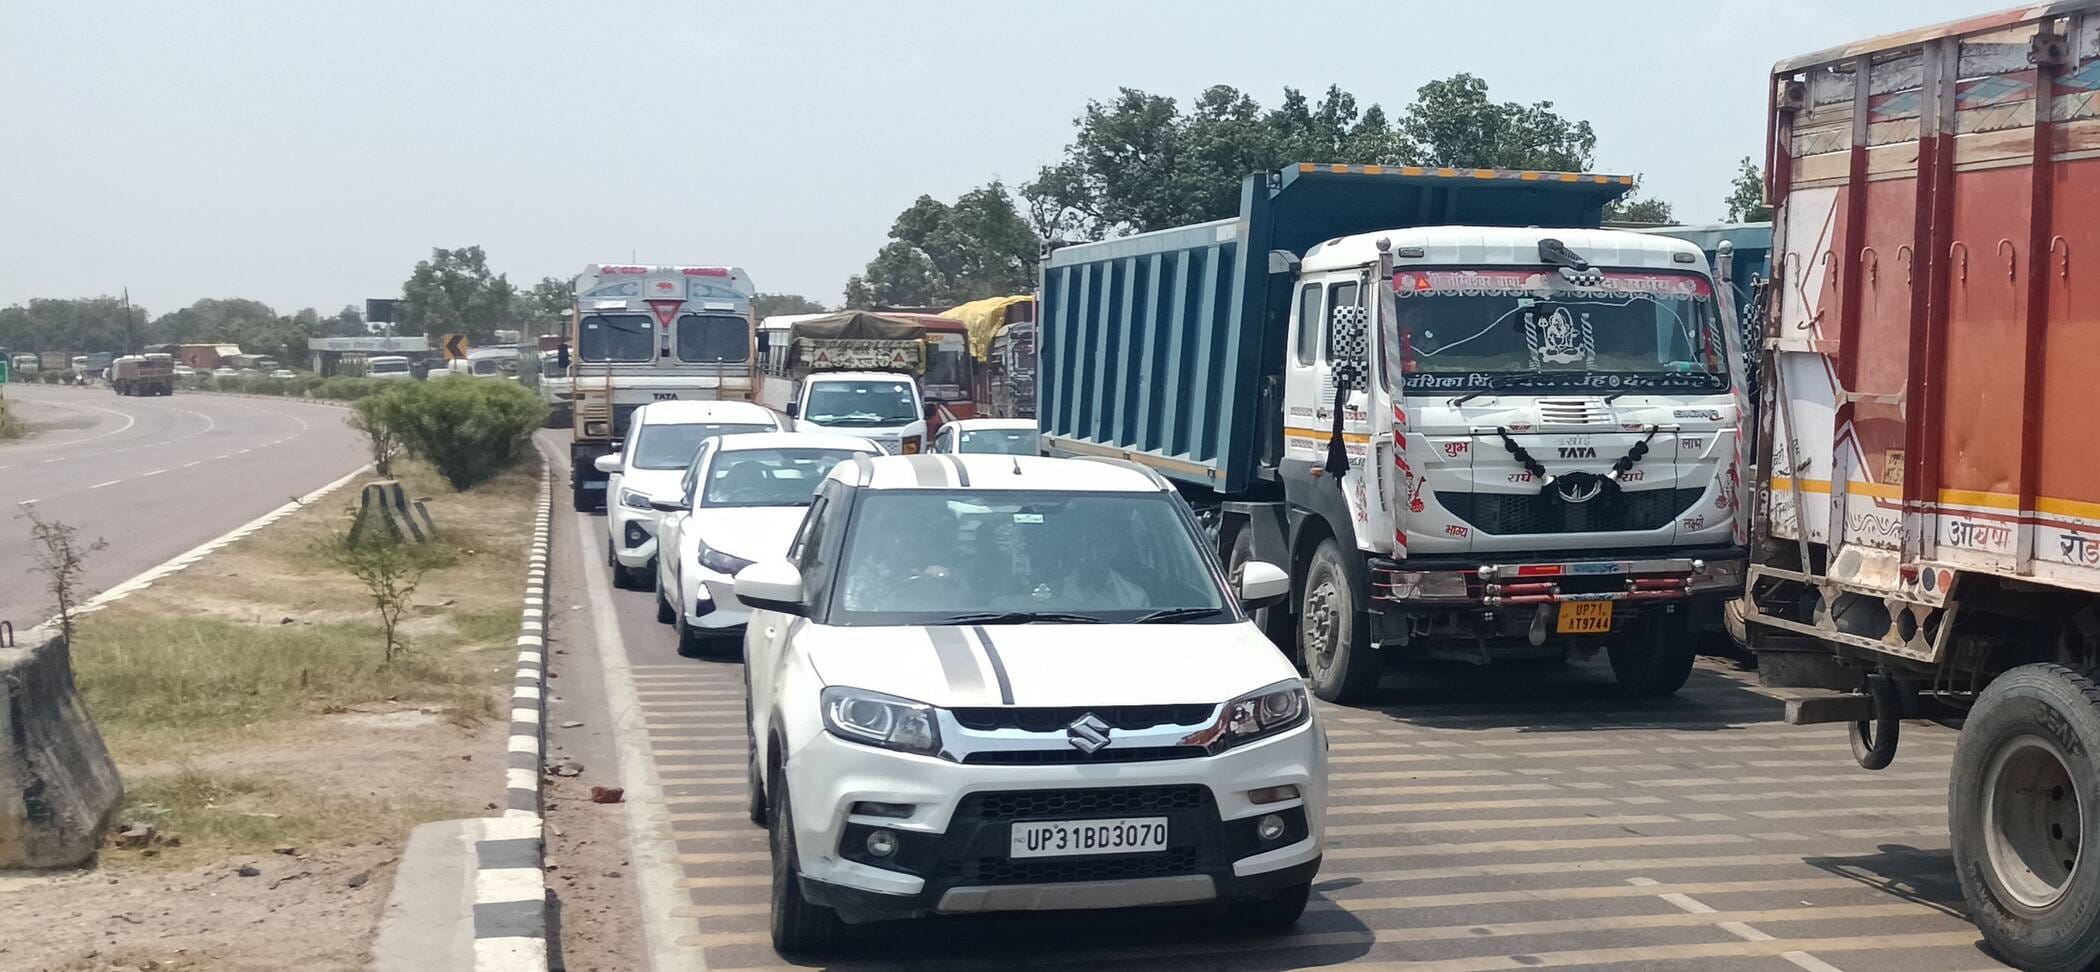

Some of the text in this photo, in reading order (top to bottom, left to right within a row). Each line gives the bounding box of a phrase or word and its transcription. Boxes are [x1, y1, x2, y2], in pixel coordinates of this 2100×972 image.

[1406, 373, 1465, 388] वंशिका
[652, 392, 680, 401] TATA
[1444, 441, 1470, 457] शुभ
[1681, 437, 1703, 450] लाभ
[1558, 447, 1597, 459] TATA
[1507, 470, 1532, 483] राधे
[1621, 471, 1644, 483] राधे
[1445, 524, 1468, 538] भाग्य
[1575, 603, 1603, 616] UP71
[1568, 617, 1609, 630] AT9744
[1027, 824, 1166, 851] UP31BD3070
